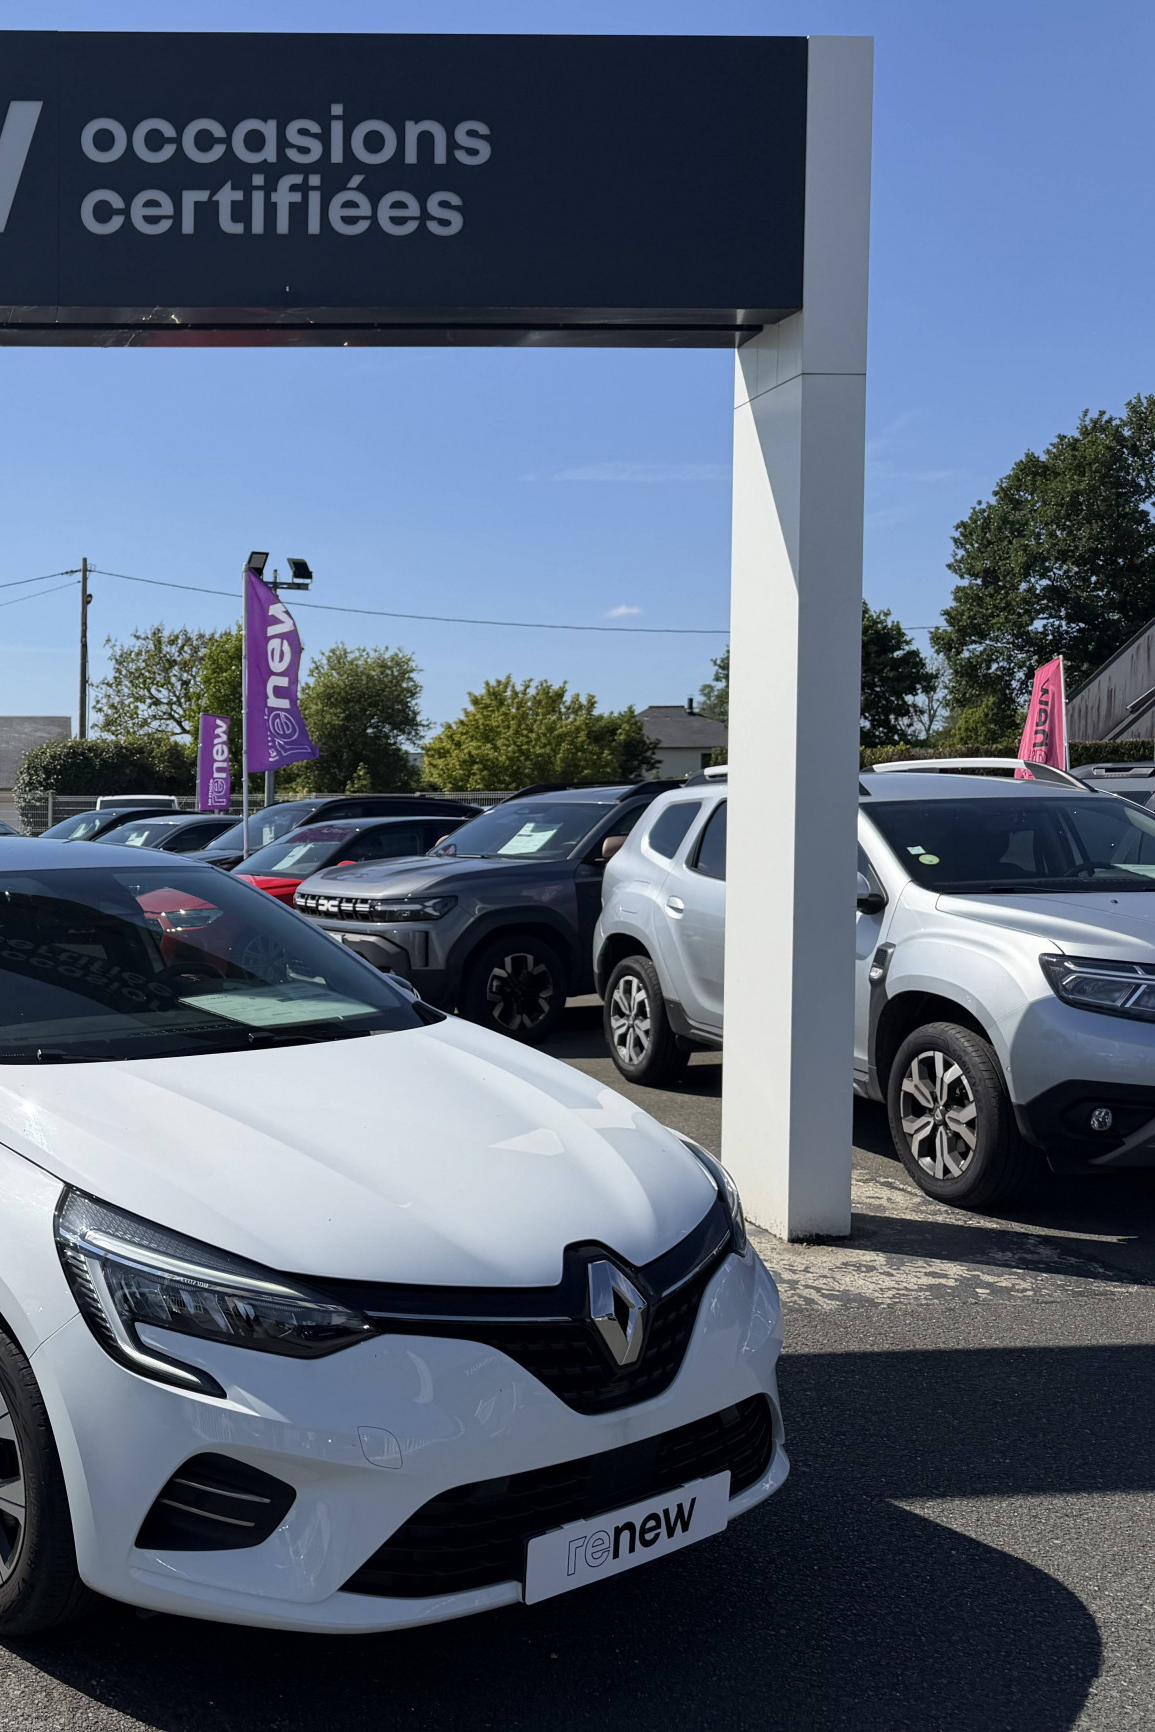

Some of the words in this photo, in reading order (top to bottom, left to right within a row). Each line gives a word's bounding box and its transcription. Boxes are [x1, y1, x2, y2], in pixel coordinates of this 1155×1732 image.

[80, 103, 492, 166] occasions
[80, 173, 464, 237] certifiées
[212, 718, 229, 806] renew
[567, 1496, 697, 1577] renew
